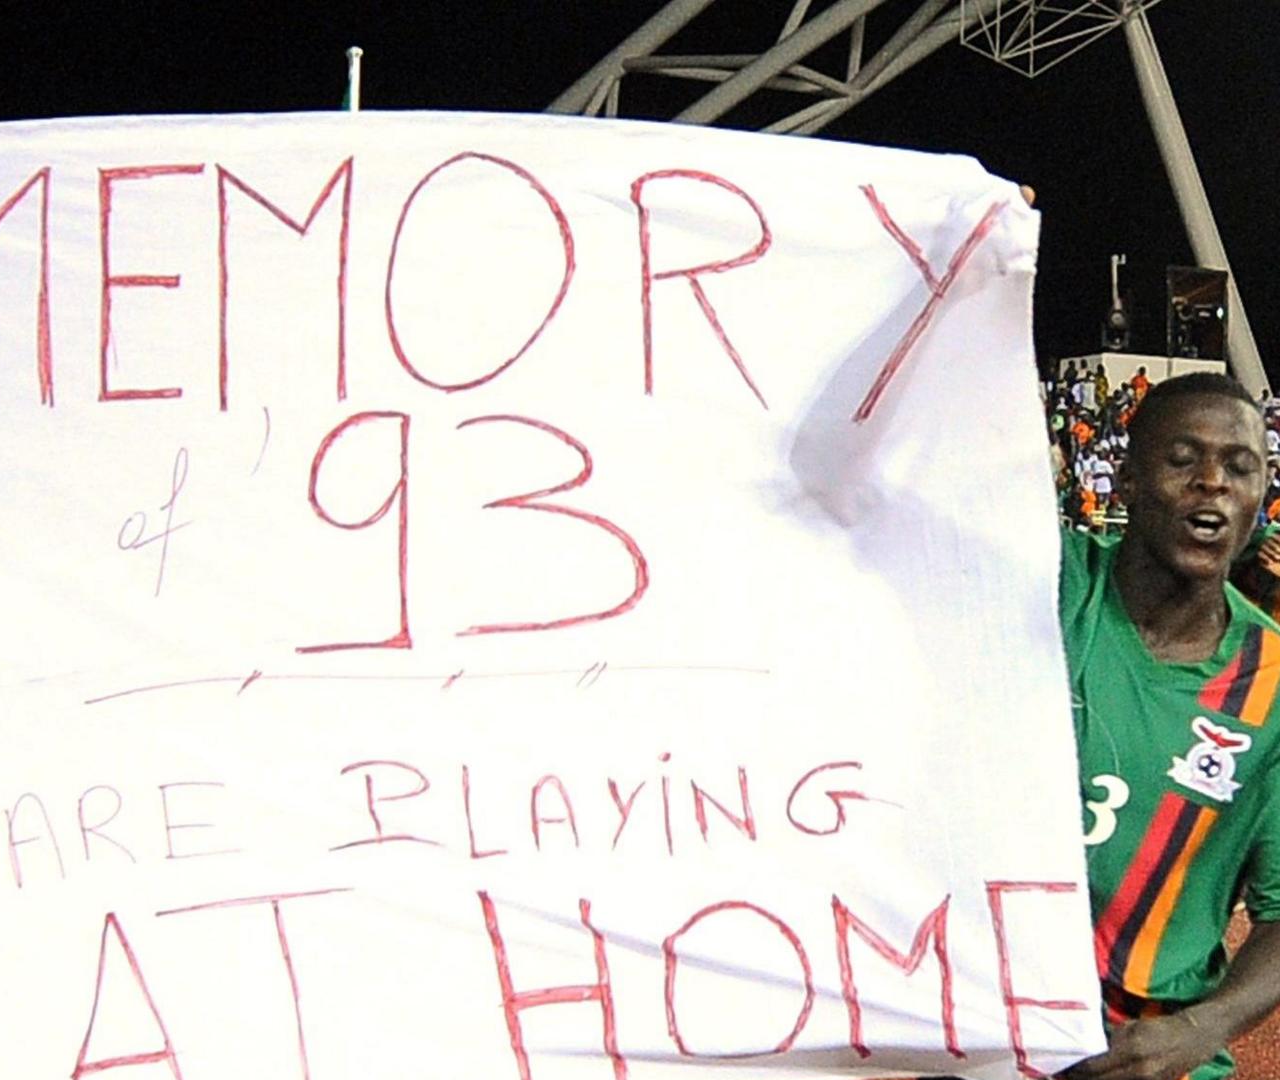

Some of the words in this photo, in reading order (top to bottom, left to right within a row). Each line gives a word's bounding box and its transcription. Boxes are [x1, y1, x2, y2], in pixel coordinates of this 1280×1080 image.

[117, 446, 195, 598] of
[4, 781, 244, 889] ARE
[1082, 774, 1130, 845] 3
